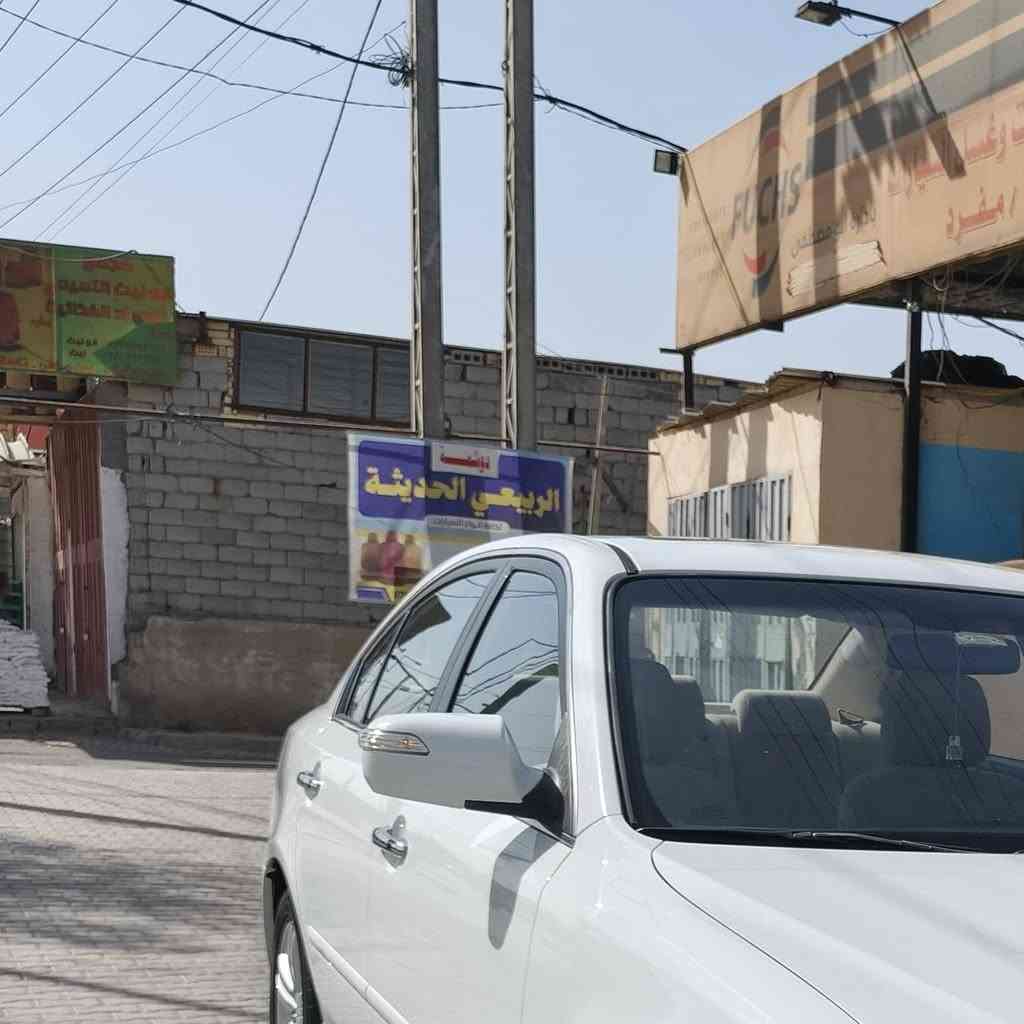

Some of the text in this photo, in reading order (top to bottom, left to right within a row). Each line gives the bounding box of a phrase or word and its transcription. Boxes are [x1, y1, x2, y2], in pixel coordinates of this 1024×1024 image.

[731, 163, 800, 240] FUCHS
[946, 186, 1004, 243] مفرد
[364, 465, 466, 504] الحديثة
